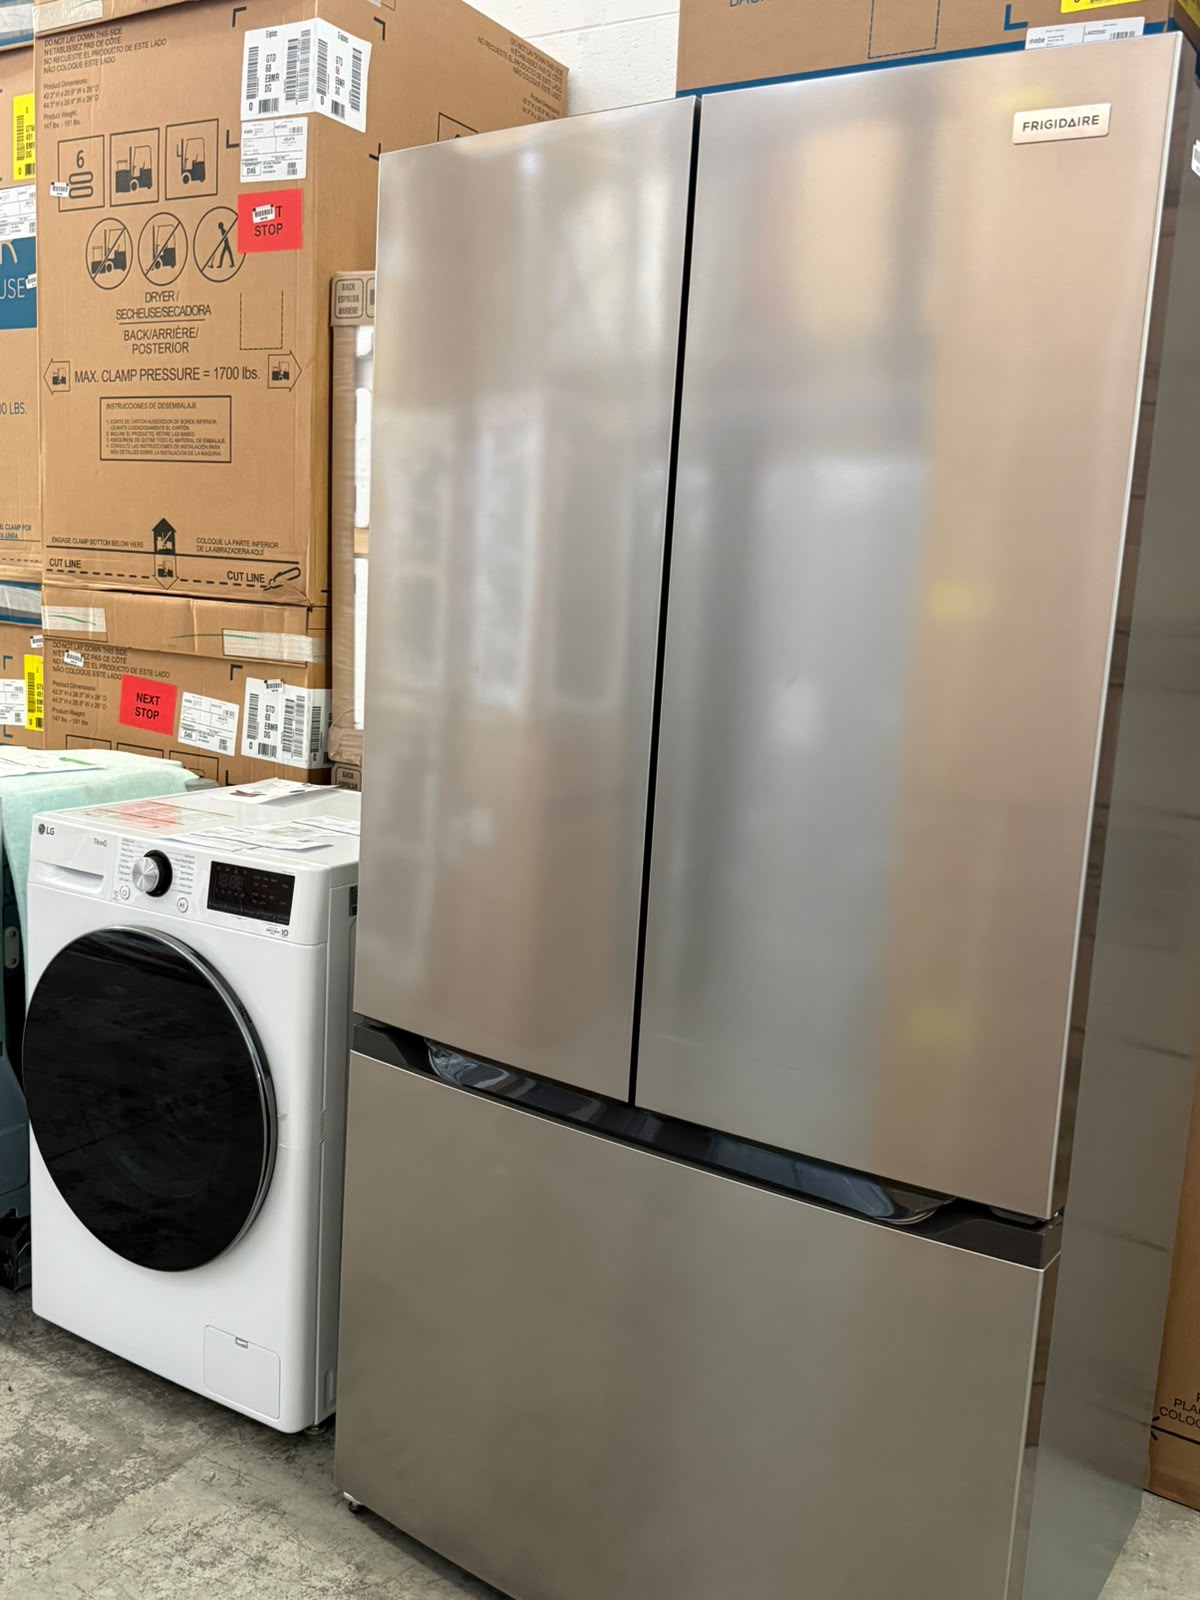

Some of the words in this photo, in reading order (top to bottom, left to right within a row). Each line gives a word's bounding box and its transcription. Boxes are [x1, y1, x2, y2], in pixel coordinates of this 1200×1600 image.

[45, 39, 53, 47] DO
[54, 37, 65, 46] NOT
[66, 36, 76, 44] LAY
[77, 32, 95, 42] DOWN
[96, 31, 109, 39] THIS
[110, 28, 122, 36] SIDE
[84, 41, 95, 49] PAS
[84, 51, 91, 59] EL
[92, 46, 123, 57] PRODUCTO
[125, 44, 133, 52] DE
[134, 42, 149, 51] ESTE
[151, 38, 167, 48] LADO
[57, 62, 83, 72] COLOQUE
[84, 59, 98, 68] ESTE
[100, 56, 116, 65] LADO
[266, 54, 277, 63] GTD
[265, 64, 271, 73] 68
[265, 84, 272, 93] DG
[1023, 115, 1100, 132] FRIGIDAIRE
[77, 150, 84, 168] 6
[255, 223, 283, 237] STOP
[145, 291, 175, 303] DRYER
[116, 305, 212, 320] SECHEUSE/SECADORA
[124, 326, 199, 341] BACK/ARRIÈRE/
[132, 342, 189, 355] POSTERIOR
[75, 371, 99, 383] MAX.
[102, 369, 137, 382] CLAMP
[140, 367, 200, 381] PRESSURE
[214, 367, 240, 380] 1700
[242, 367, 260, 380] lbs.
[10, 402, 27, 415] LBS.
[196, 537, 224, 545] COLOQUE
[50, 558, 63, 567] CUT
[65, 559, 81, 568] LINE
[227, 570, 244, 581] CUT
[246, 573, 265, 583] LINE
[85, 645, 100, 653] DOWN
[65, 668, 91, 676] COLOQUE
[107, 672, 122, 680] LADO
[100, 663, 129, 673] PRODUCTO
[140, 668, 153, 676] ESTE
[155, 670, 170, 678] LADO
[53, 680, 69, 688] Product
[136, 692, 160, 706] NEXT
[135, 707, 159, 720] STOP
[46, 827, 55, 836] LG
[94, 838, 107, 847] ThinQ
[1174, 1397, 1200, 1415] PLA
